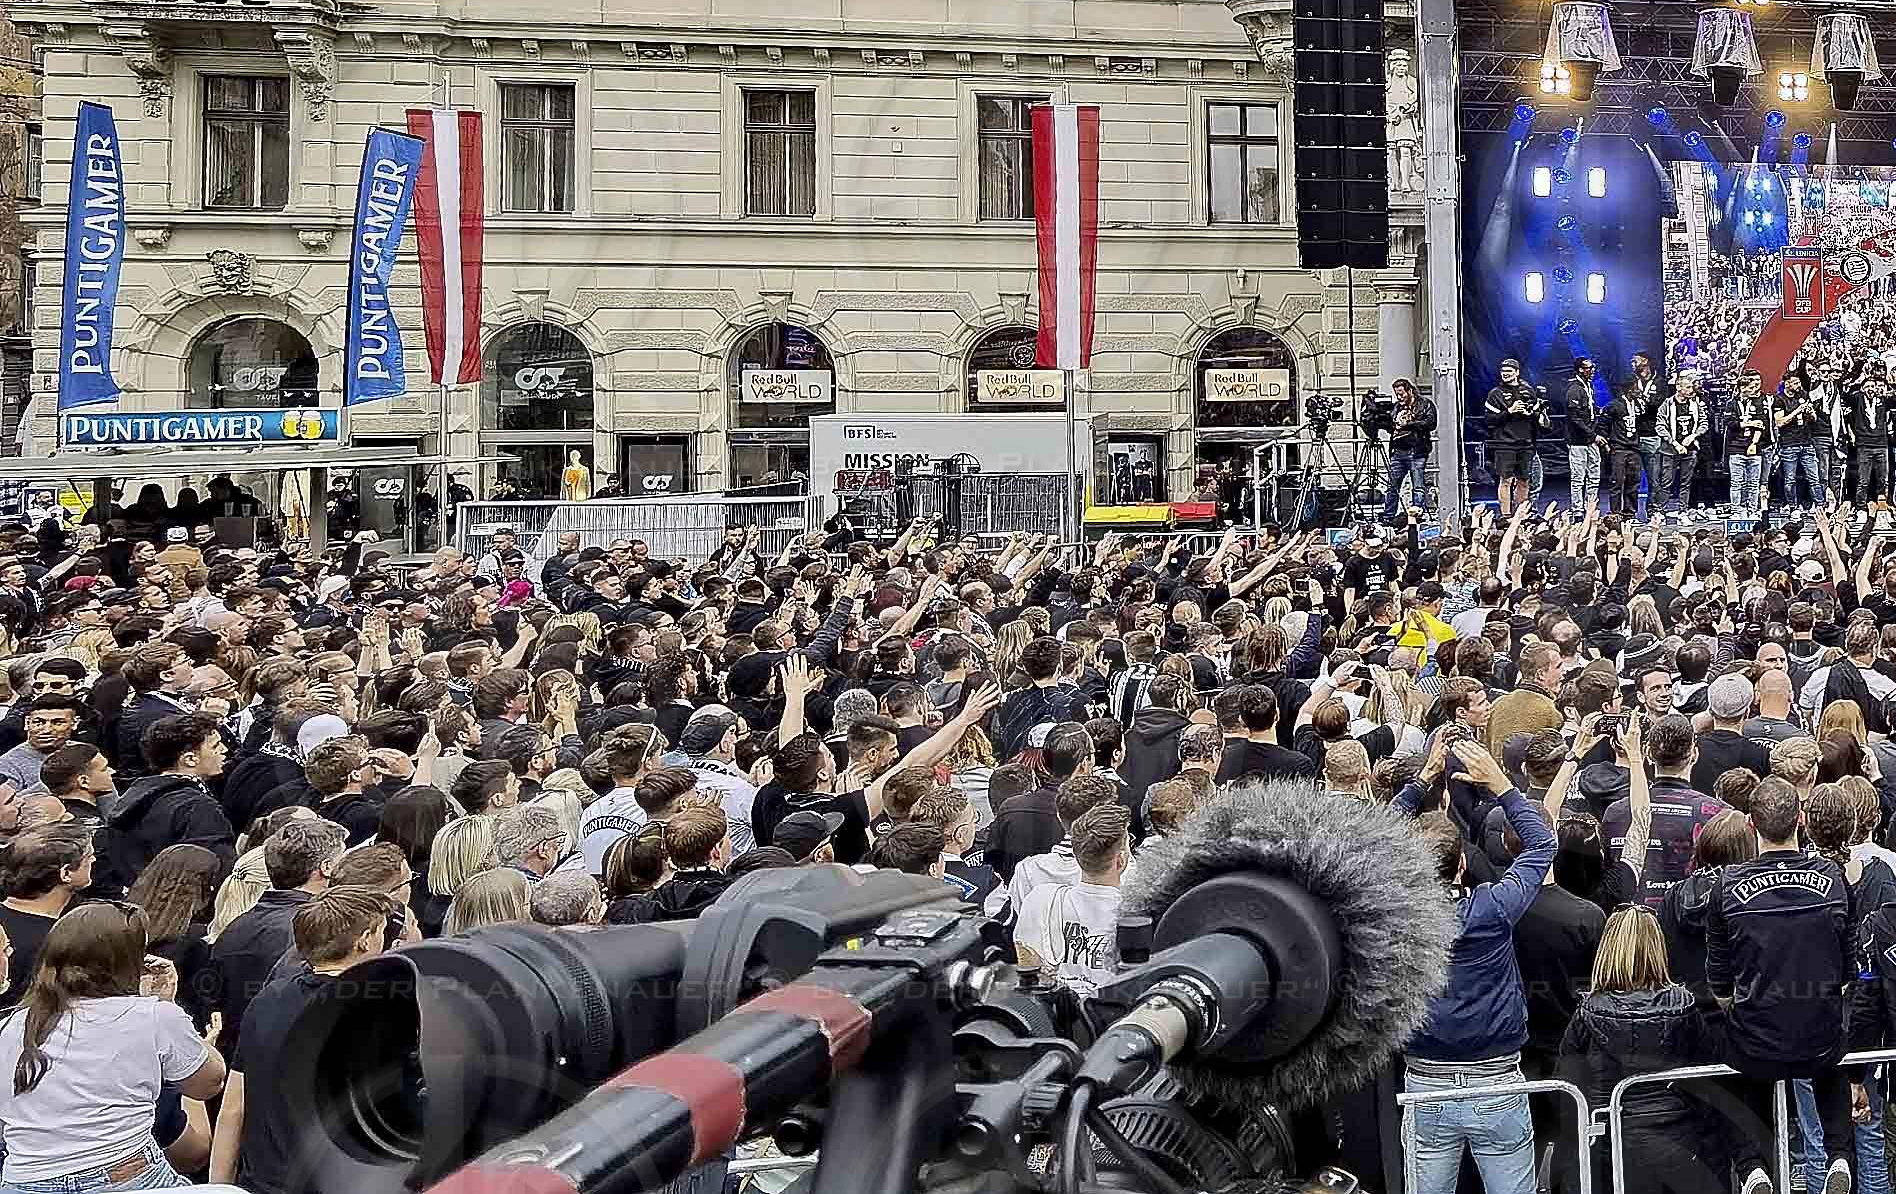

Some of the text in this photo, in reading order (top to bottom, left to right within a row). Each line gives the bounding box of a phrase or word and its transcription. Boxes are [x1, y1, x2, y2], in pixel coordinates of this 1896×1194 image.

[70, 132, 122, 374] PUNTIGAMER
[357, 156, 410, 381] PUNTIGAMER
[751, 373, 797, 385] Red Bull
[986, 373, 1032, 385] Red Bull
[1214, 372, 1258, 384] Red Bull
[751, 384, 822, 399] WORLD
[986, 384, 1055, 399] WORLD
[1214, 383, 1282, 398] WORLD
[70, 415, 265, 443] PUNTIGAMER
[847, 428, 872, 439] BFS
[1741, 871, 1827, 899] PUNTIGAMER
